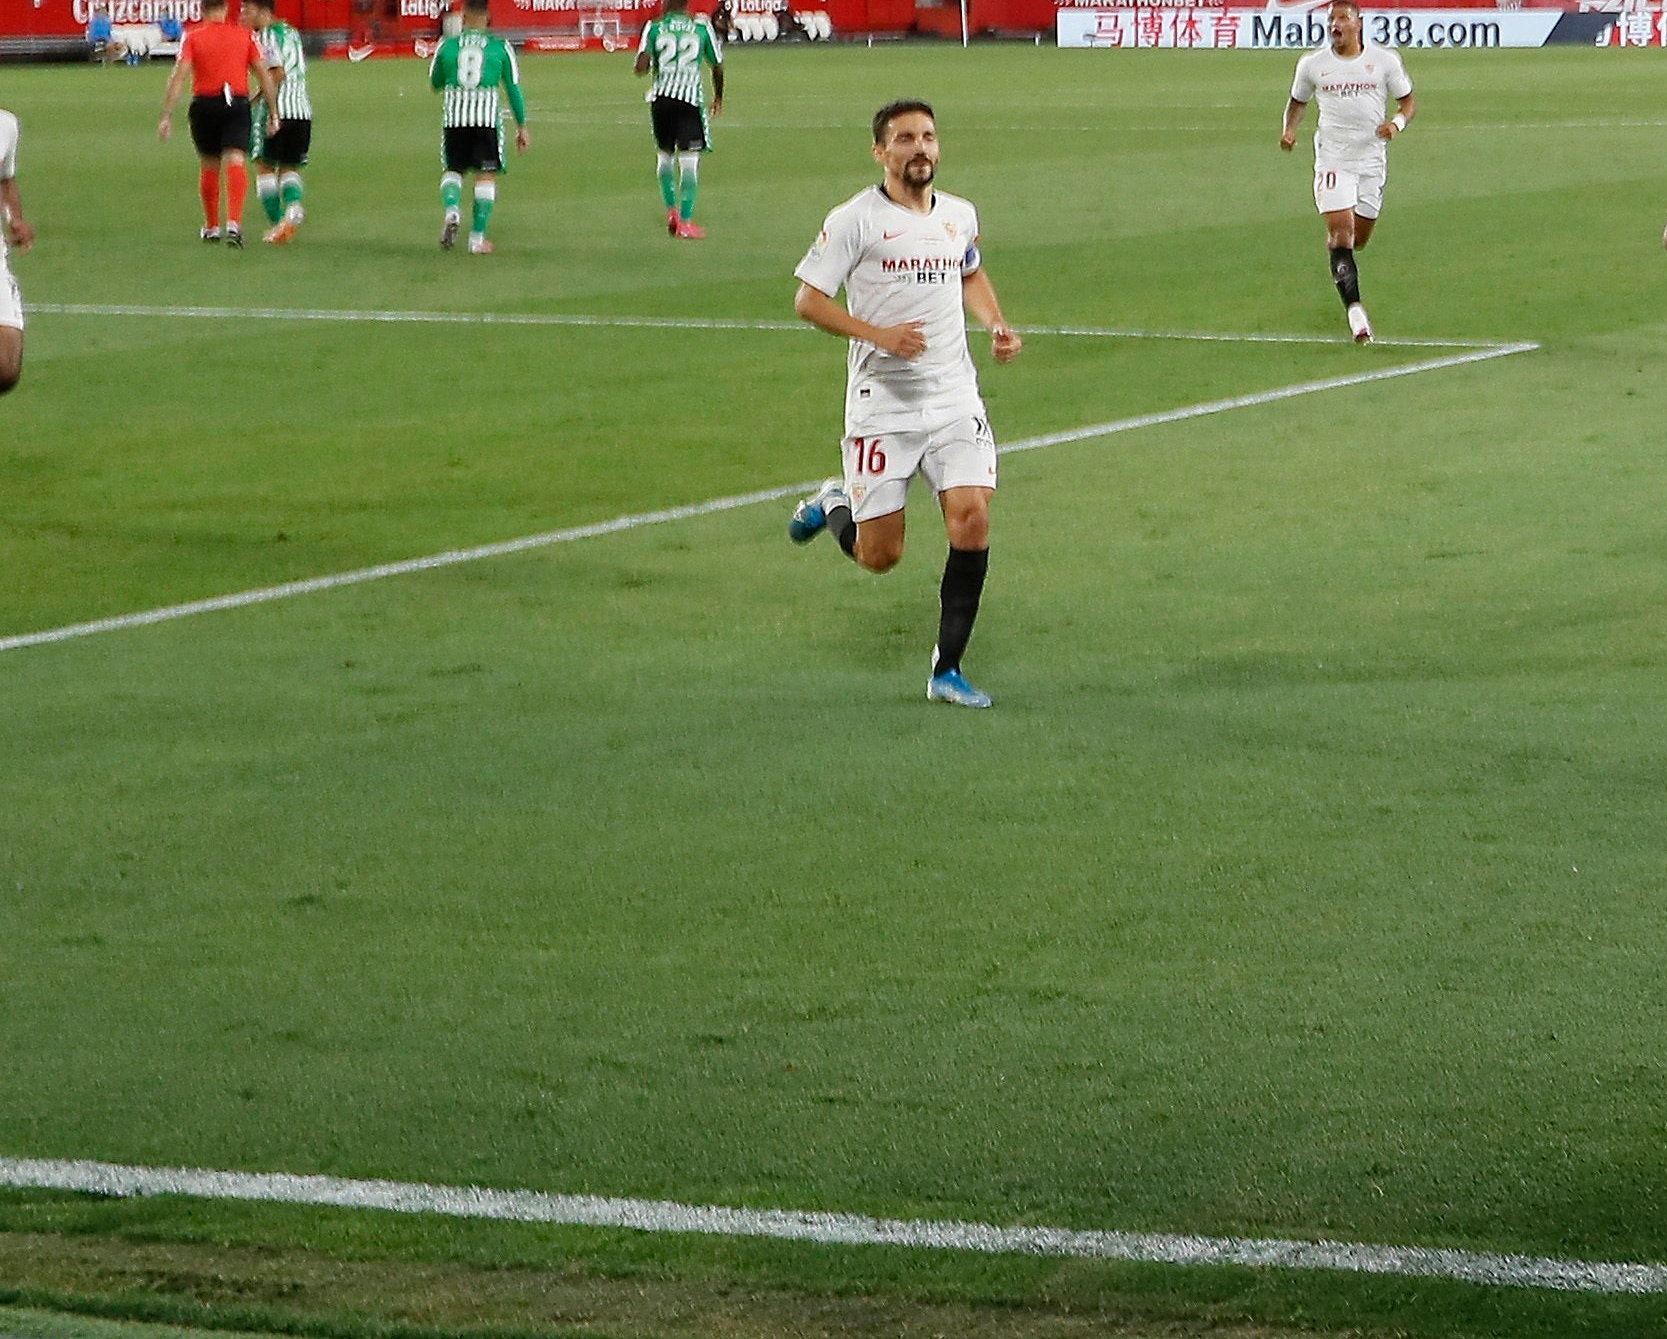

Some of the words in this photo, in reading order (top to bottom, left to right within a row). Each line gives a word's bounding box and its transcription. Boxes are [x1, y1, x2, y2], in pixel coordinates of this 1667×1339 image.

[1095, 11, 1241, 48] 马博体育
[1252, 15, 1500, 48] Mab38.com
[457, 46, 484, 89] 8
[655, 32, 699, 72] 22
[882, 257, 962, 273] MARATHO
[916, 272, 947, 284] BET
[855, 437, 886, 475] 16
